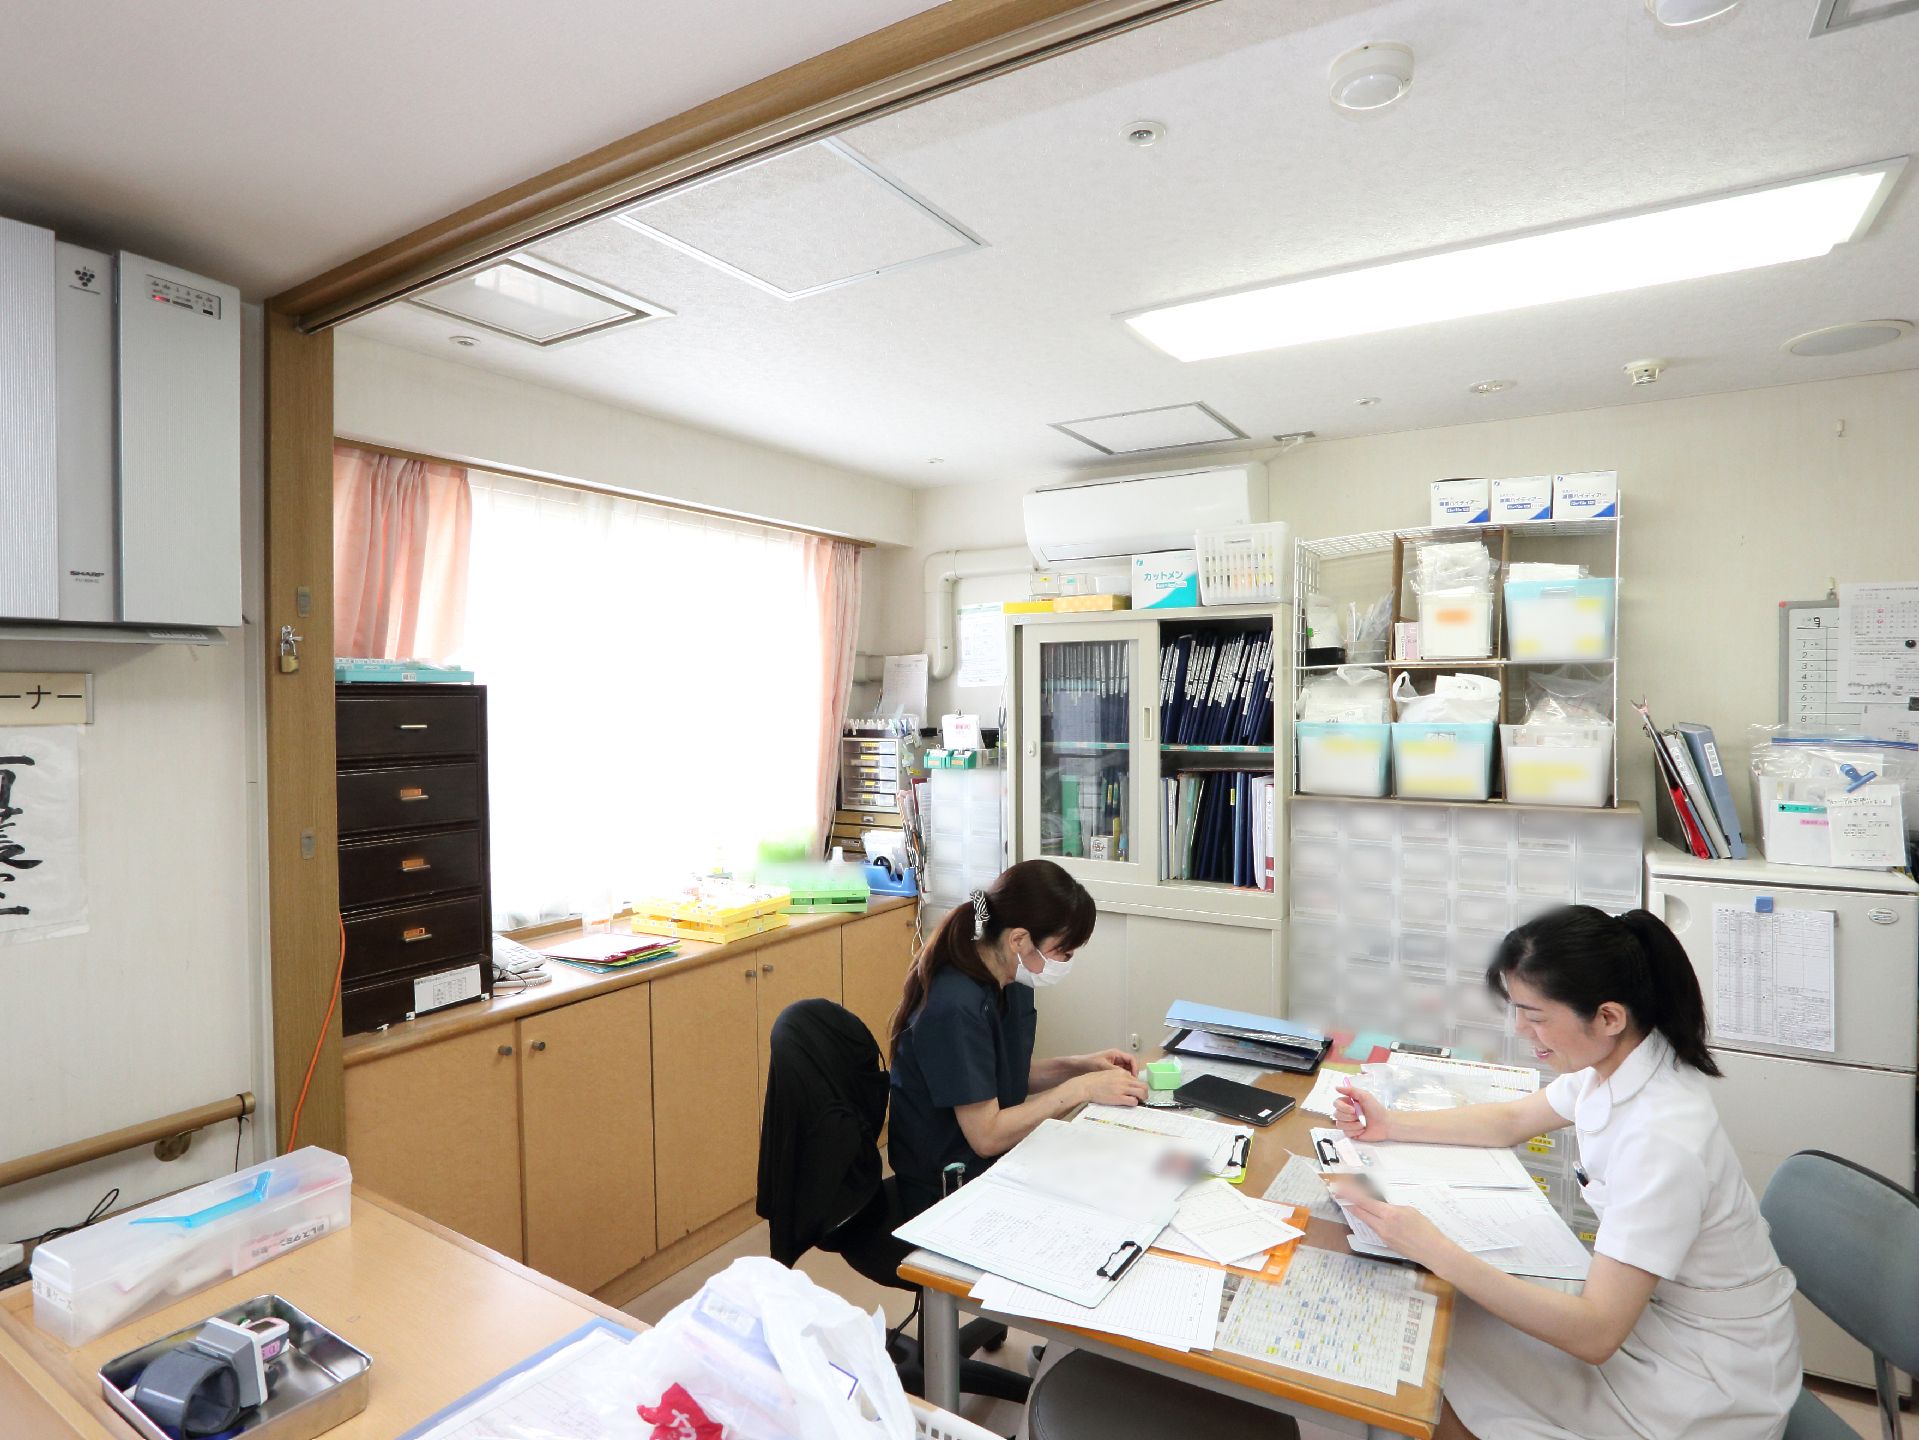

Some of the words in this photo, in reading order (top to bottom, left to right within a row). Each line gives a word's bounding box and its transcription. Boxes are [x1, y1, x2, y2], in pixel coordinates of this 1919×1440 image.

[69, 570, 105, 578] SHARP
[1144, 570, 1184, 582] カットメン
